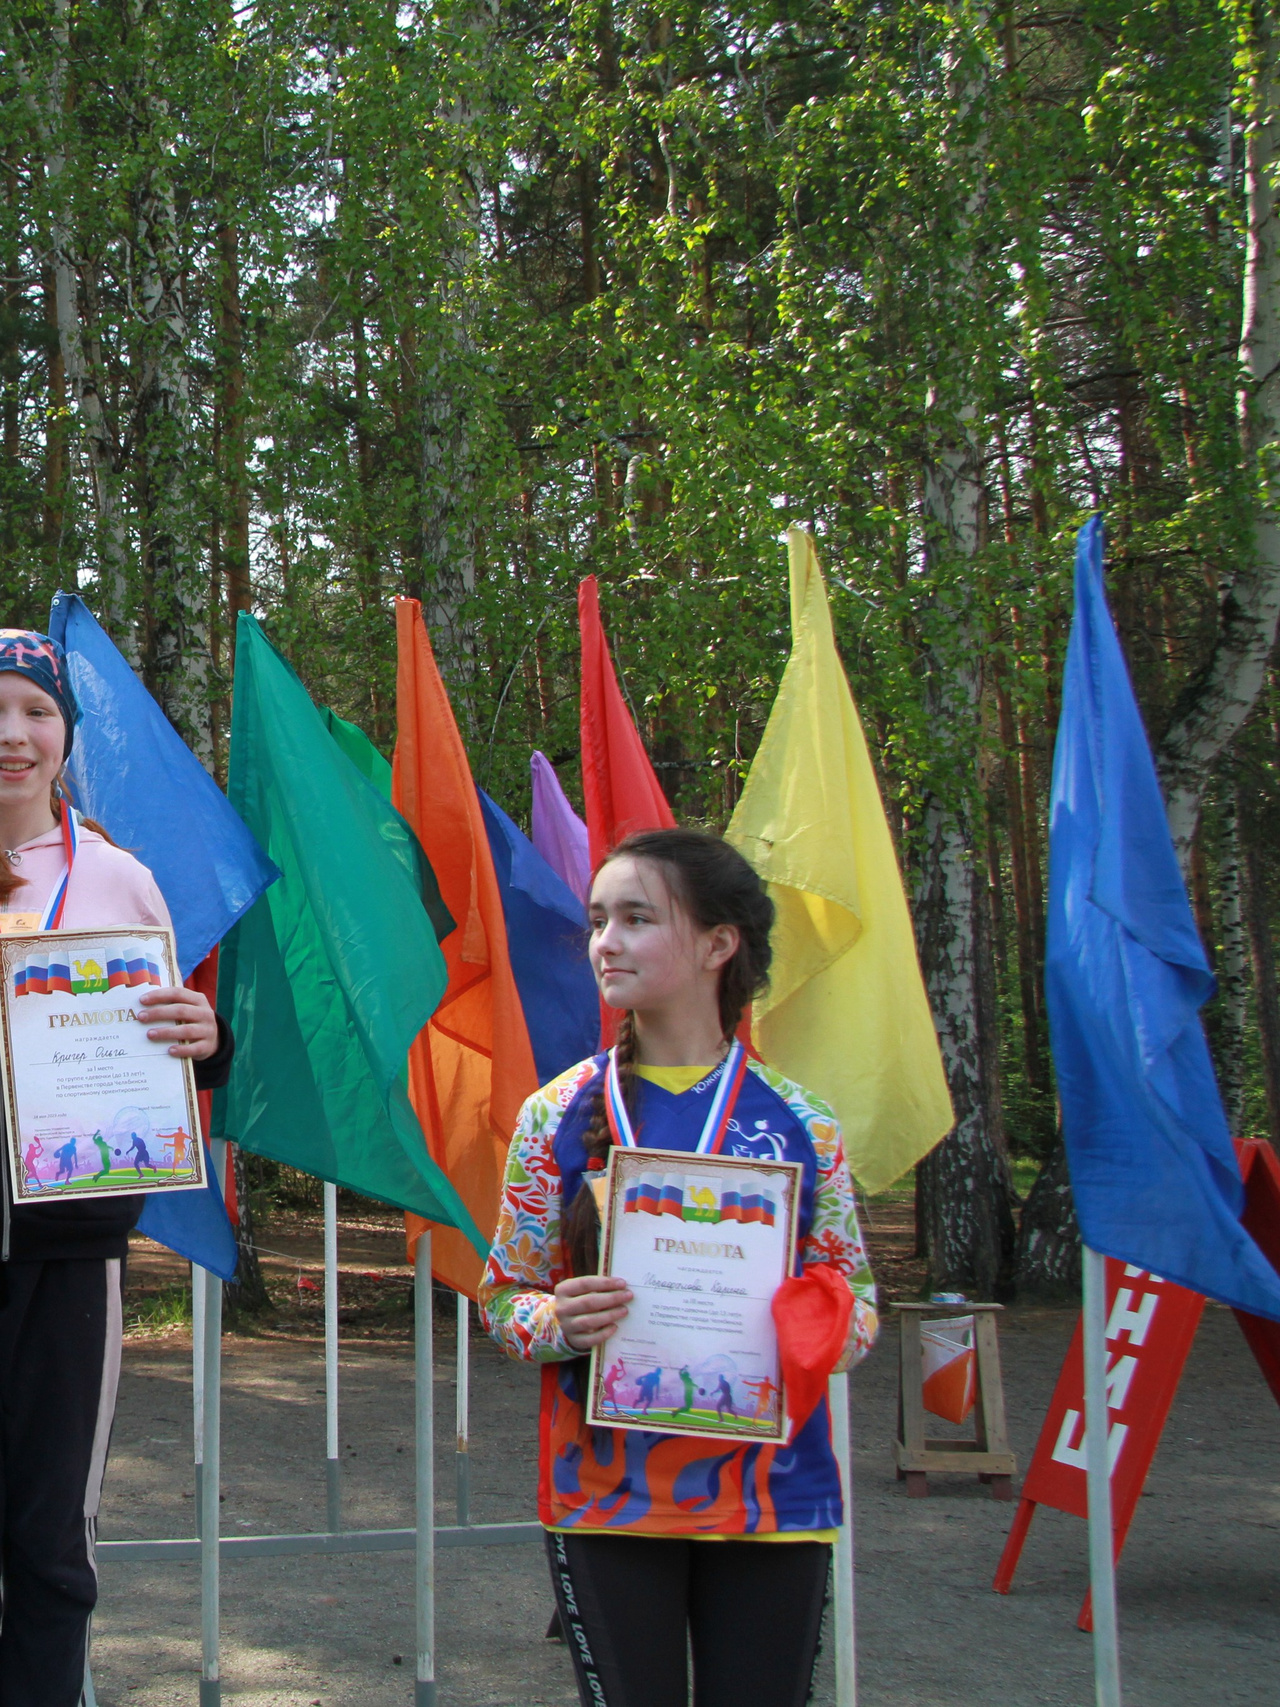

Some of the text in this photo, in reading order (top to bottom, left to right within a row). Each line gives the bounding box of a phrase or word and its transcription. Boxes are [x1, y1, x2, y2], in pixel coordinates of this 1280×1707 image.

[48, 1008, 138, 1028] ГРАМОТА
[95, 1046, 128, 1058] Ольга
[61, 1083, 93, 1091] Первенстве
[64, 1090, 100, 1099] спортивному
[653, 1237, 745, 1259] ГРАМОТА
[555, 1533, 567, 1565] OVE
[560, 1573, 579, 1615] LOVE
[572, 1623, 593, 1665] LOVE
[586, 1672, 607, 1707] LOVE
